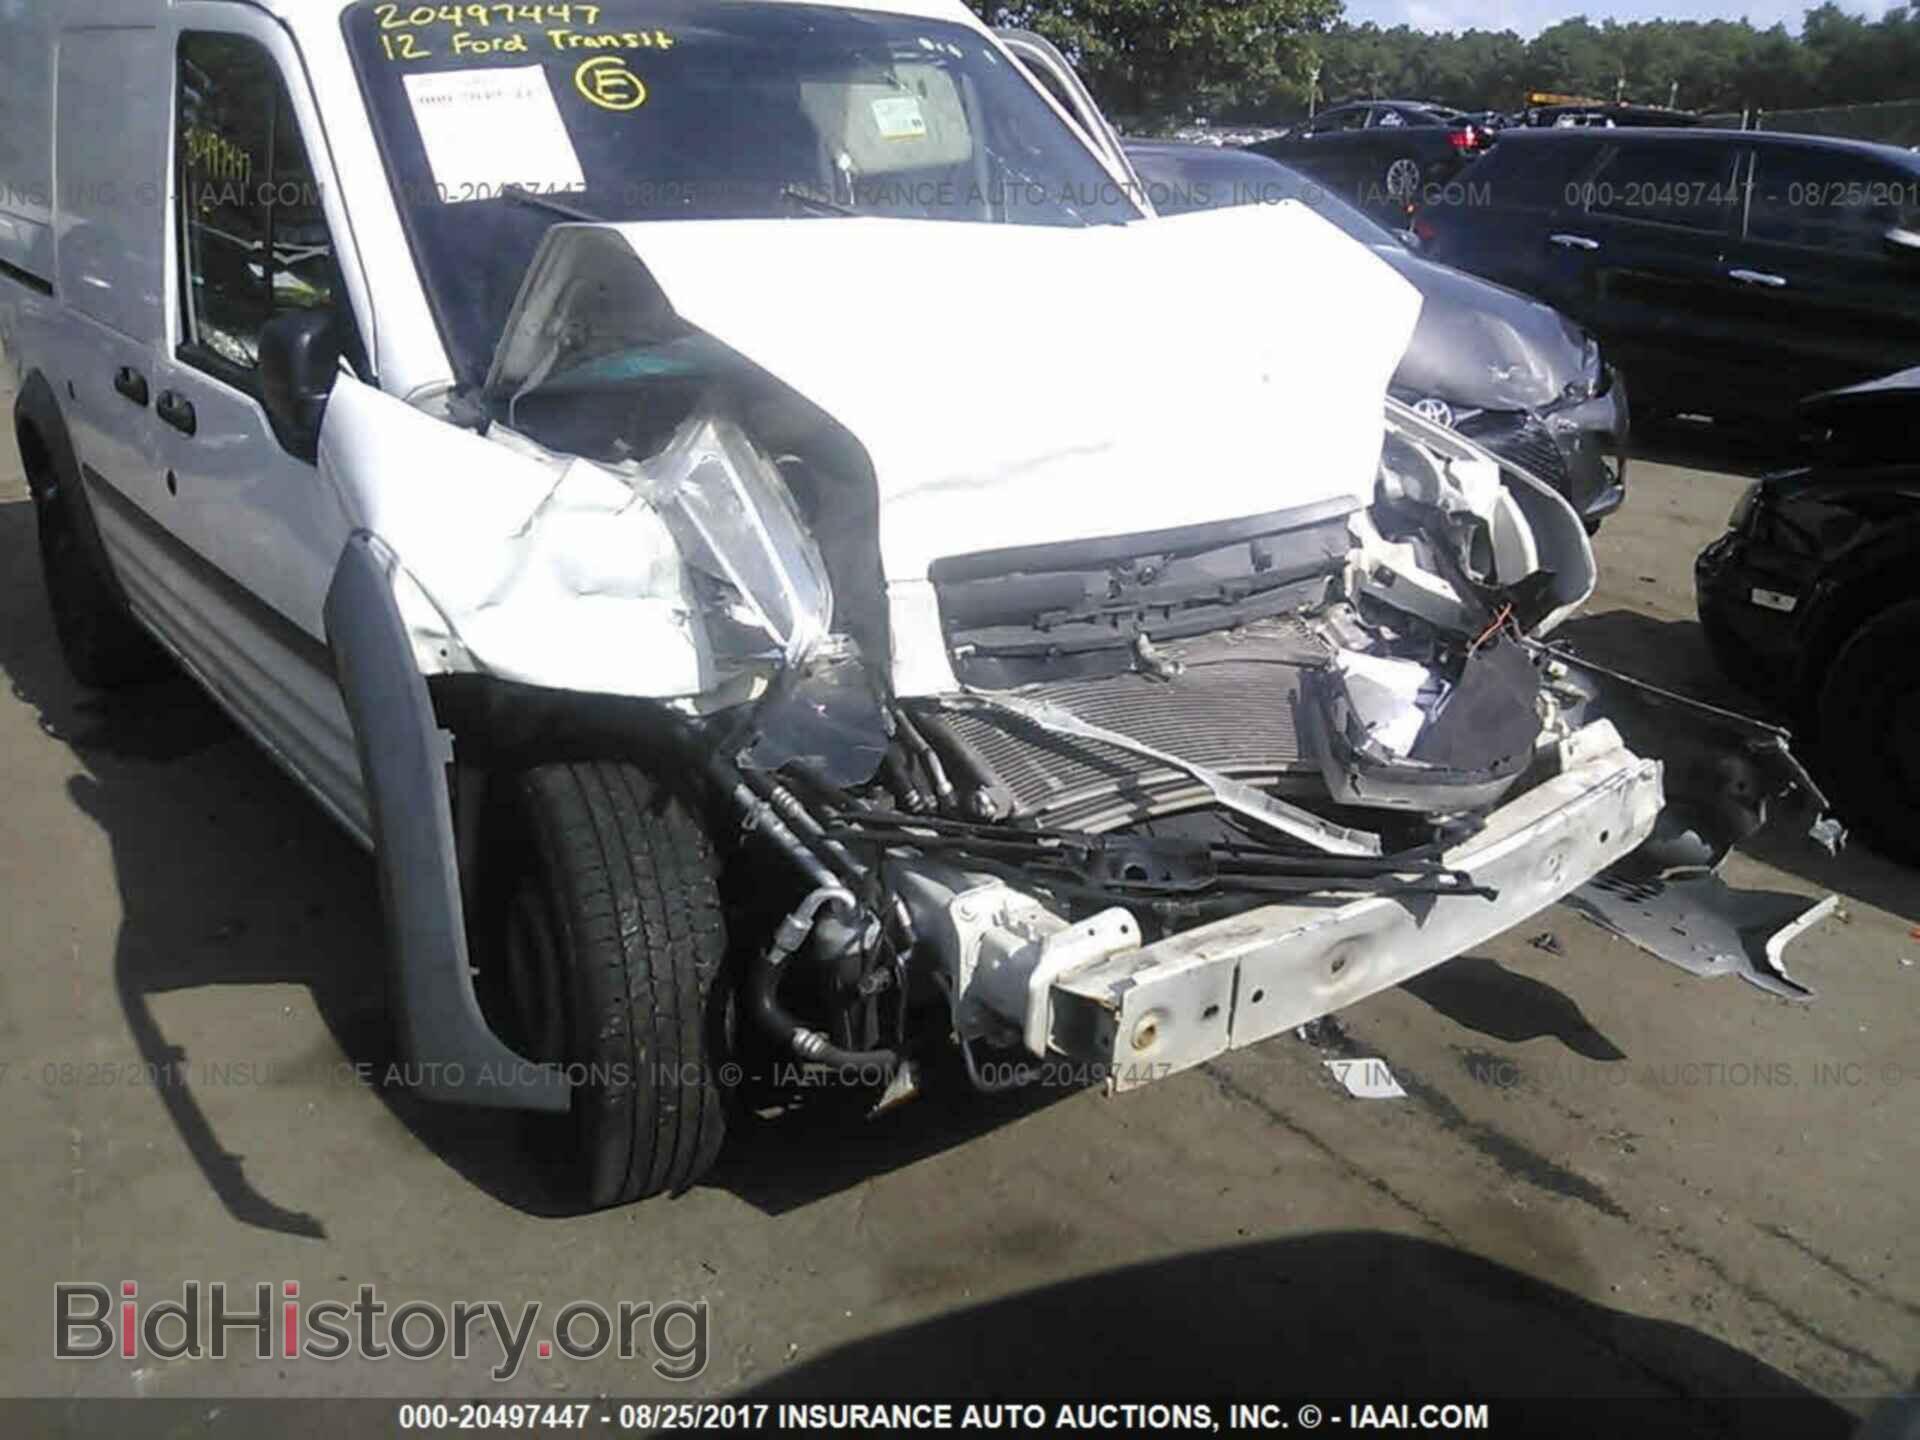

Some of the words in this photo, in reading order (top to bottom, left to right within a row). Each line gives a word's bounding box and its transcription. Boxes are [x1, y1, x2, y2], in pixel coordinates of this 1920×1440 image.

[374, 4, 600, 29] 20497447
[381, 35, 431, 60] 12
[453, 32, 528, 54] Ford
[549, 30, 673, 49] Transit
